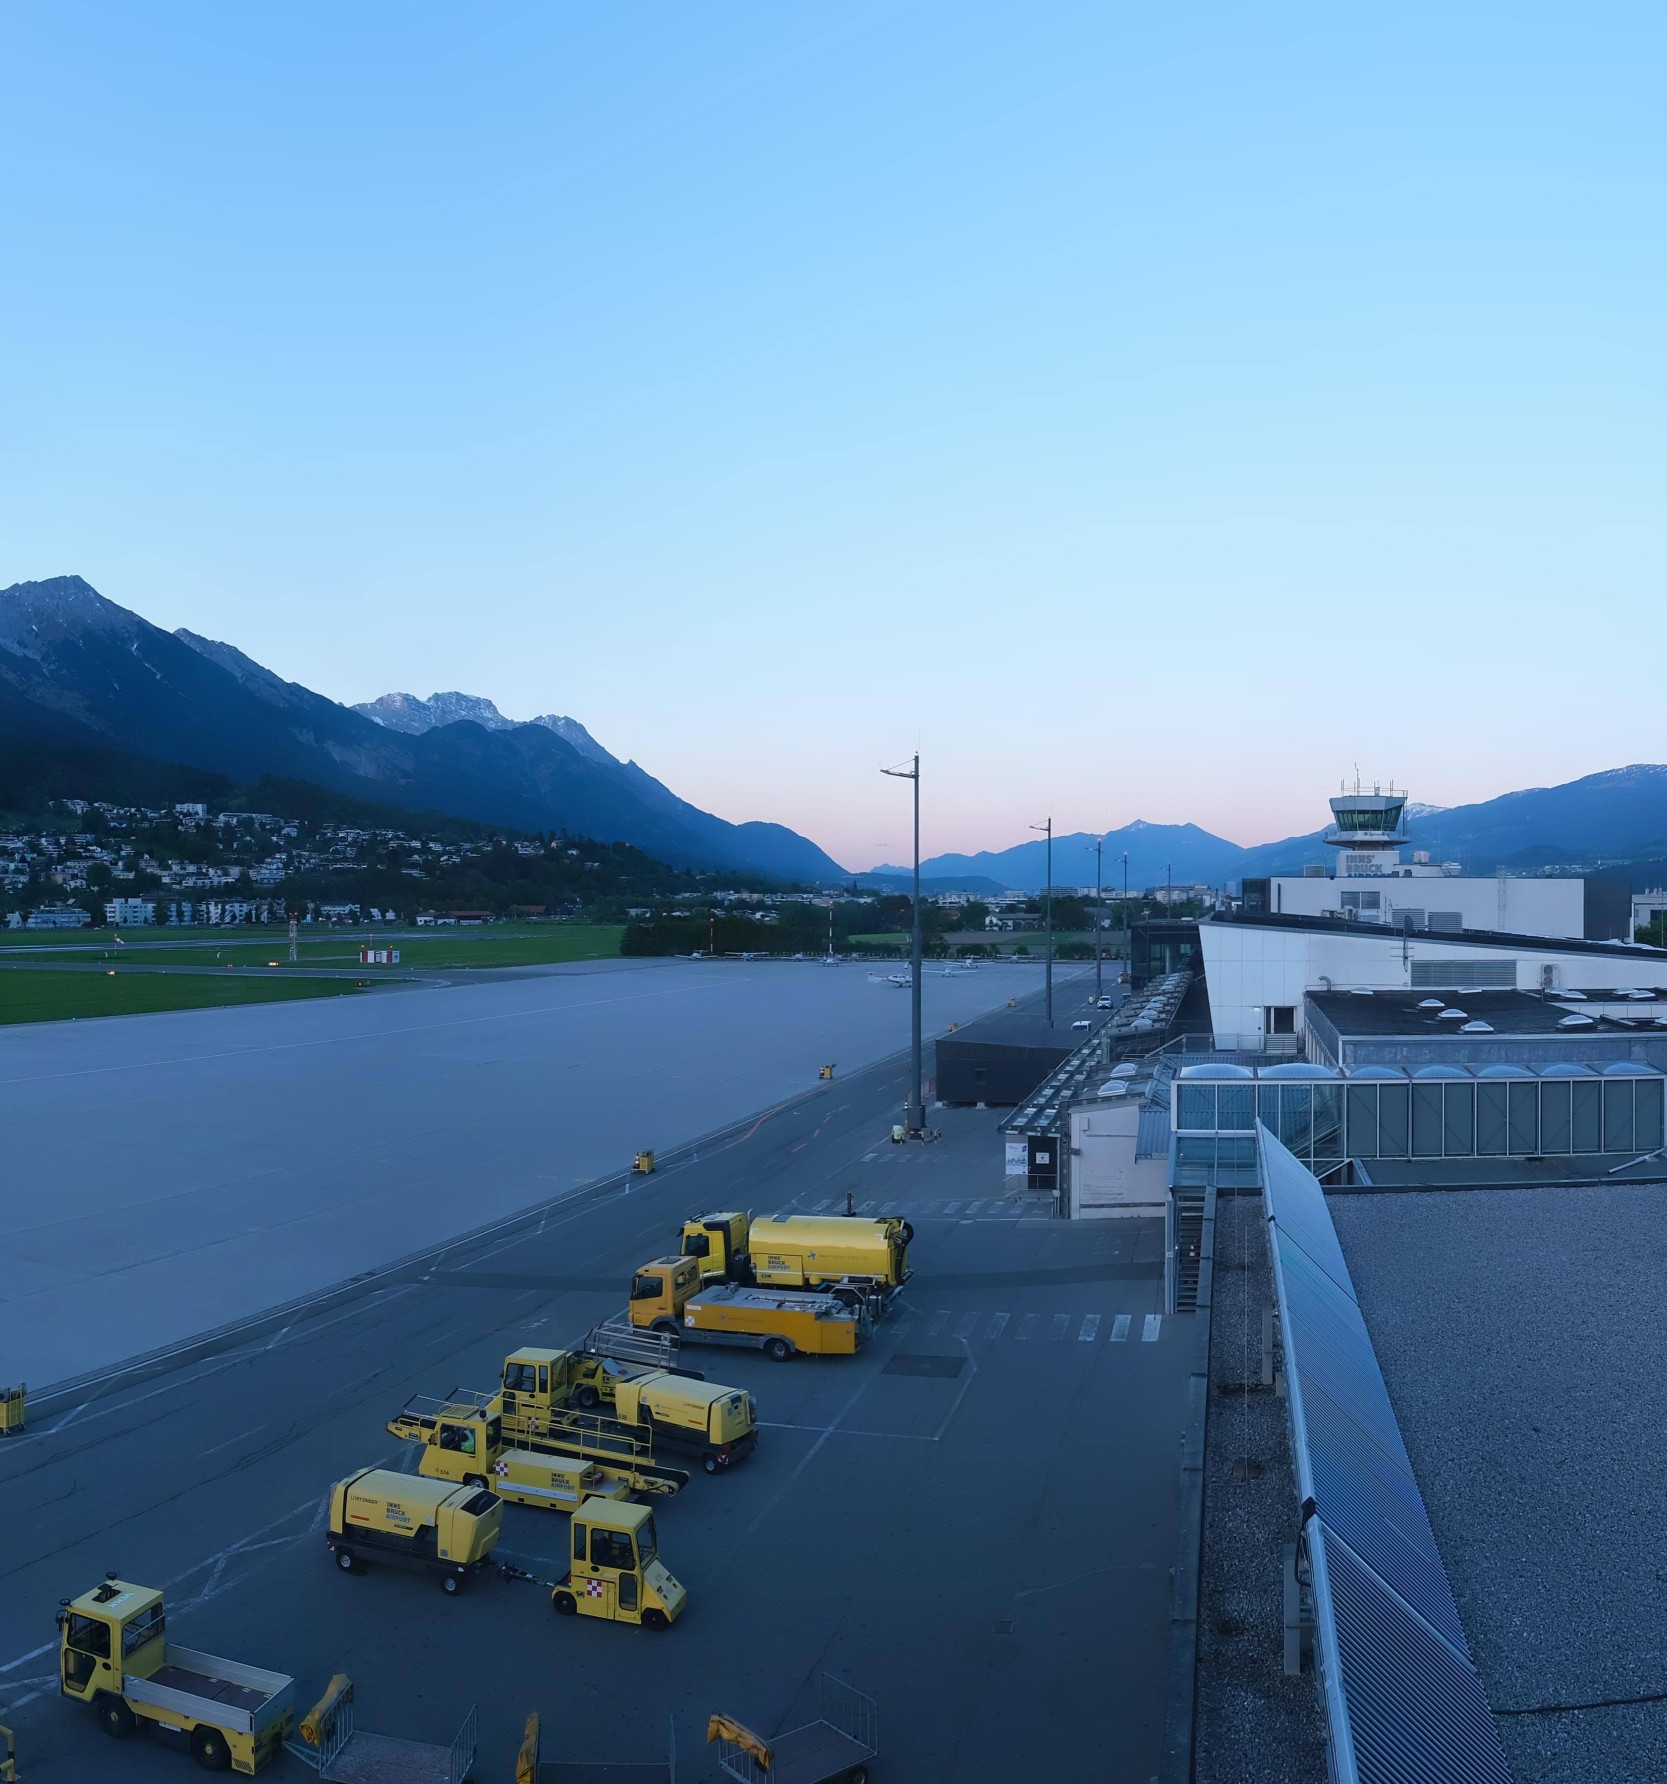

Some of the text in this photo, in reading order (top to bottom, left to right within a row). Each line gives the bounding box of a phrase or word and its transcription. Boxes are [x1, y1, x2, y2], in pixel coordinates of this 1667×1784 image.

[1346, 854, 1375, 864] INNS'
[1346, 863, 1382, 873] BRUCK
[386, 1507, 406, 1517] BRUCK
[386, 1513, 411, 1523] AIRPORT
